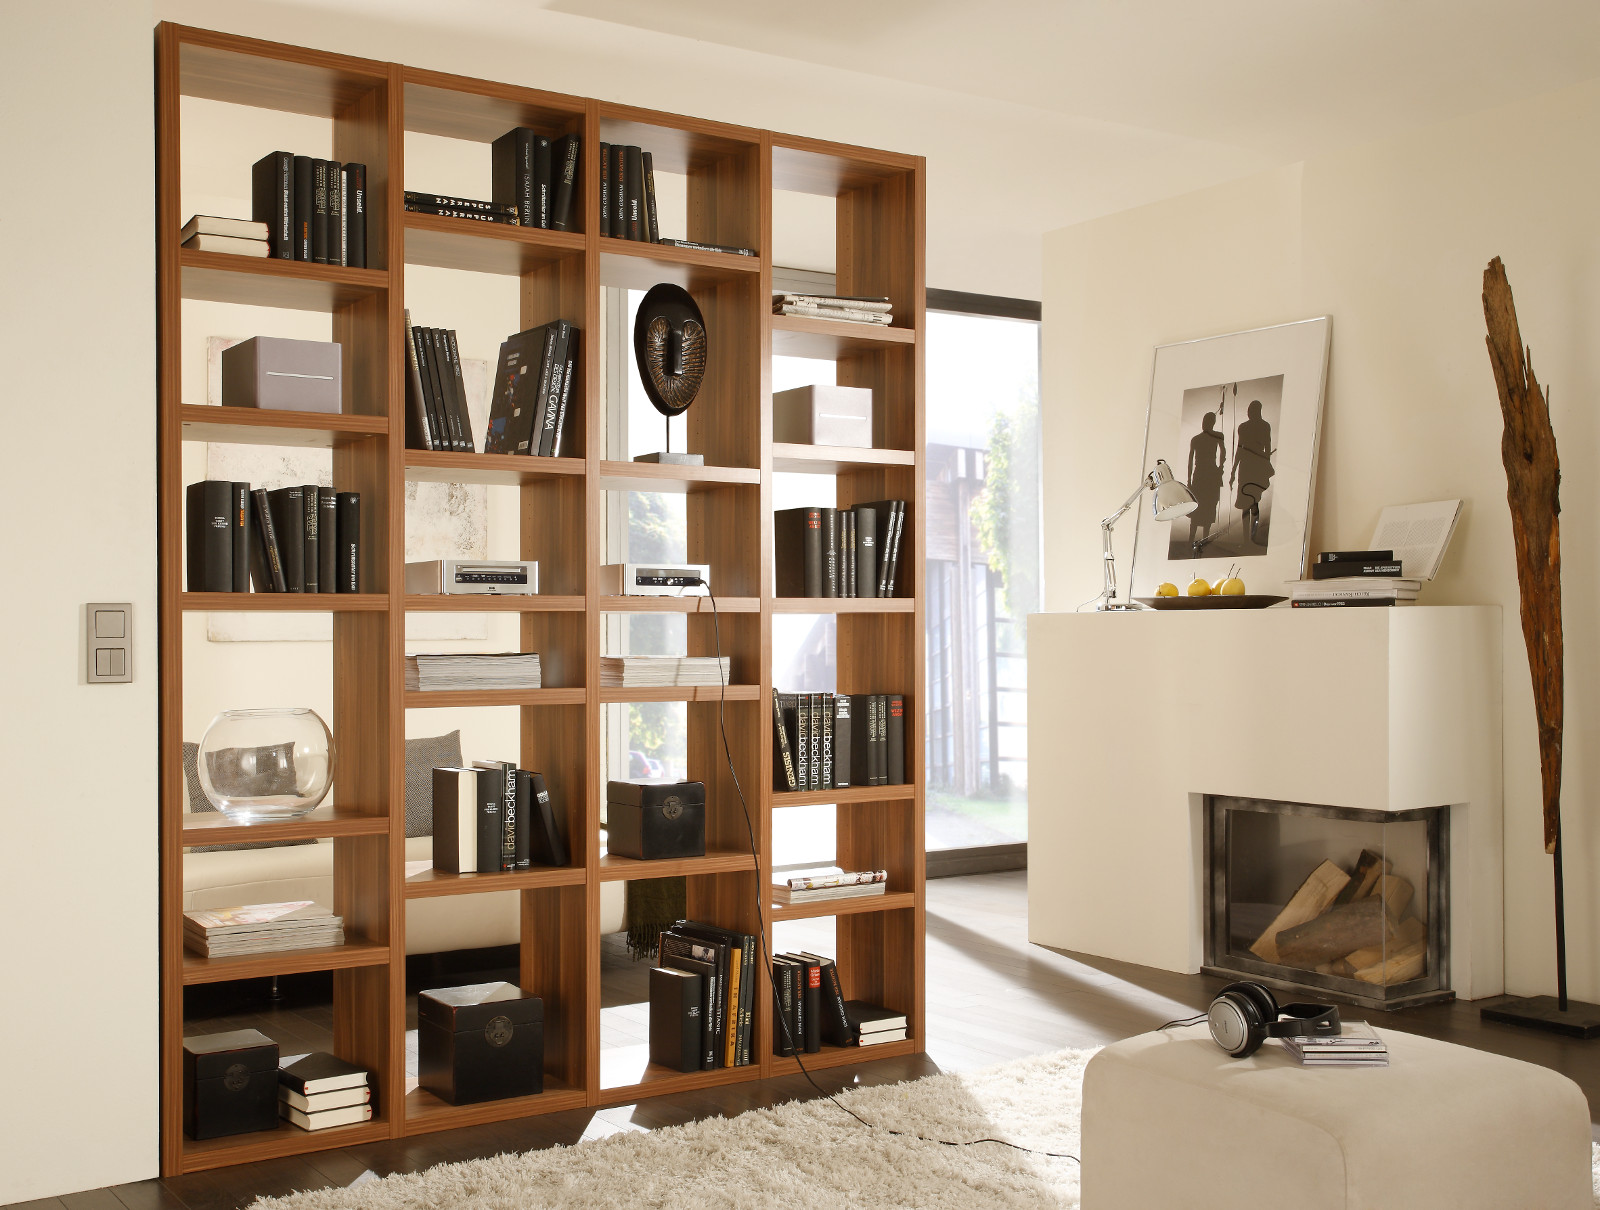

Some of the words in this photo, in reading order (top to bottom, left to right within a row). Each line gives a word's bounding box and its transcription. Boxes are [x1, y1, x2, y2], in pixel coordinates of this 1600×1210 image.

[435, 197, 491, 210] SUPERMAN
[438, 209, 494, 222] SUPERMAN
[545, 395, 558, 430] GAVINA
[799, 712, 808, 786] davidbeckham
[811, 711, 821, 785] davidbeckham
[823, 713, 833, 784] davidbeckham
[504, 769, 516, 850] davidbeckham
